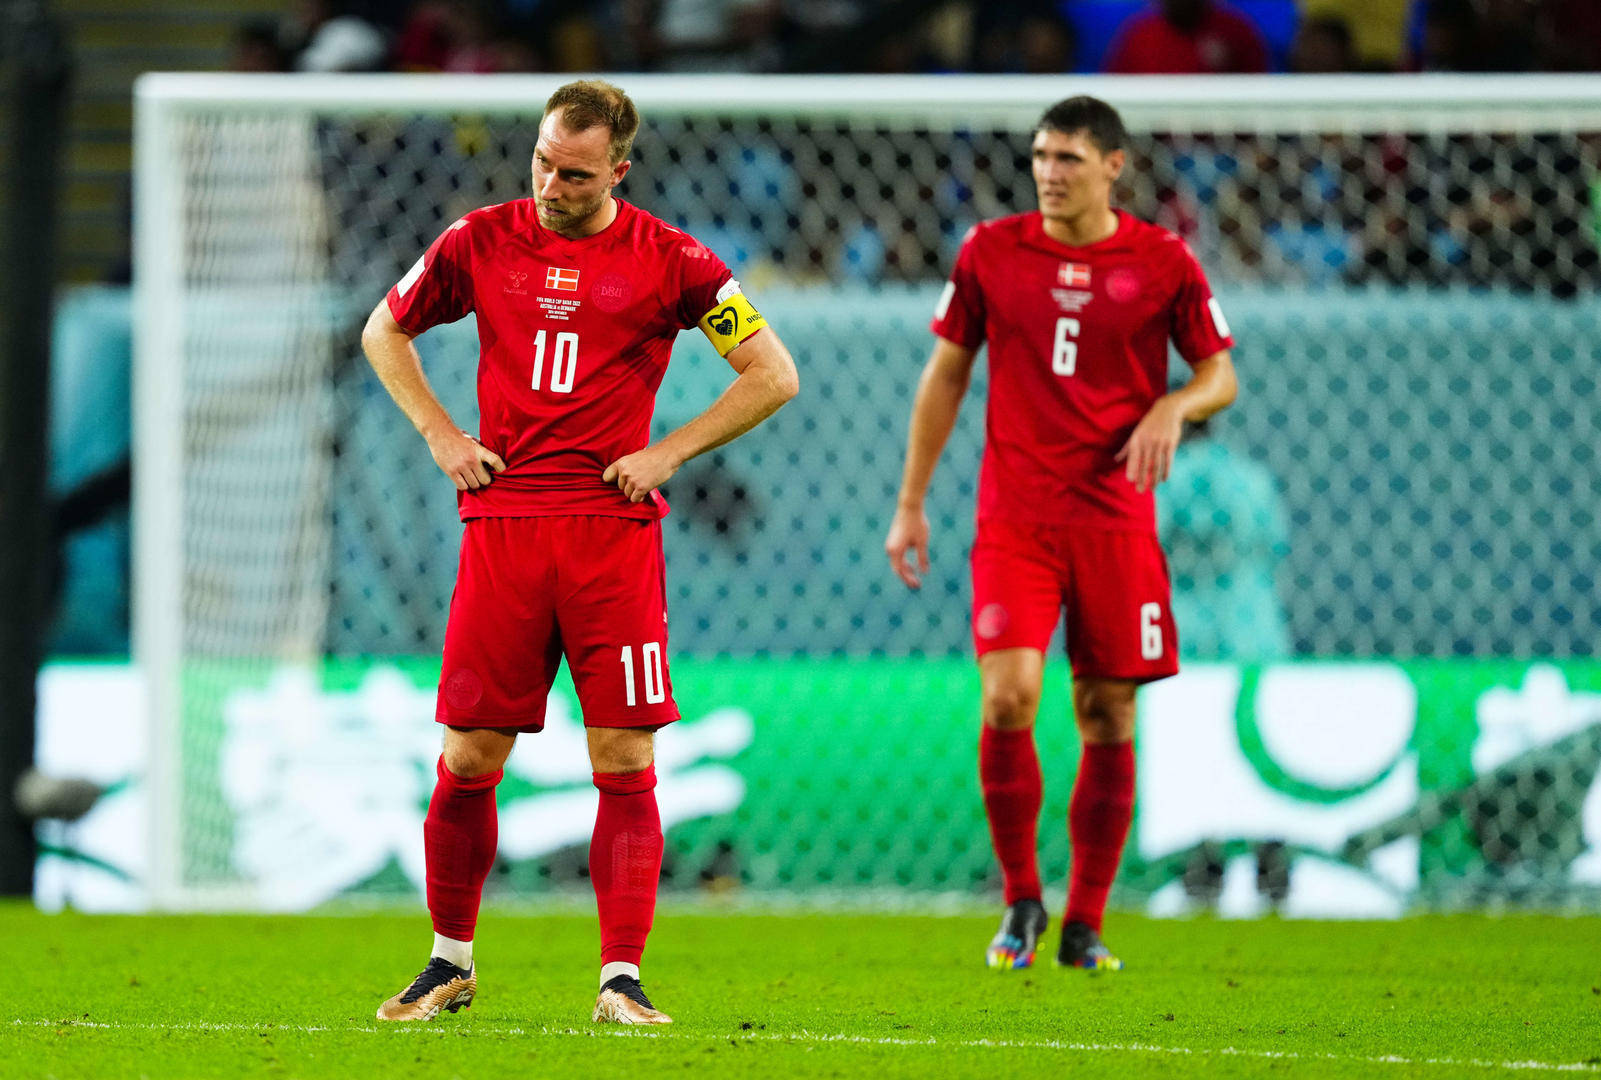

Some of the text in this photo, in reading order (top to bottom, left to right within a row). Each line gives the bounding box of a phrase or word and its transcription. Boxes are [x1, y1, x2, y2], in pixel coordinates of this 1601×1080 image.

[531, 329, 579, 394] 10
[1052, 317, 1080, 377] 6
[1140, 602, 1163, 661] 6
[620, 641, 665, 707] 10
